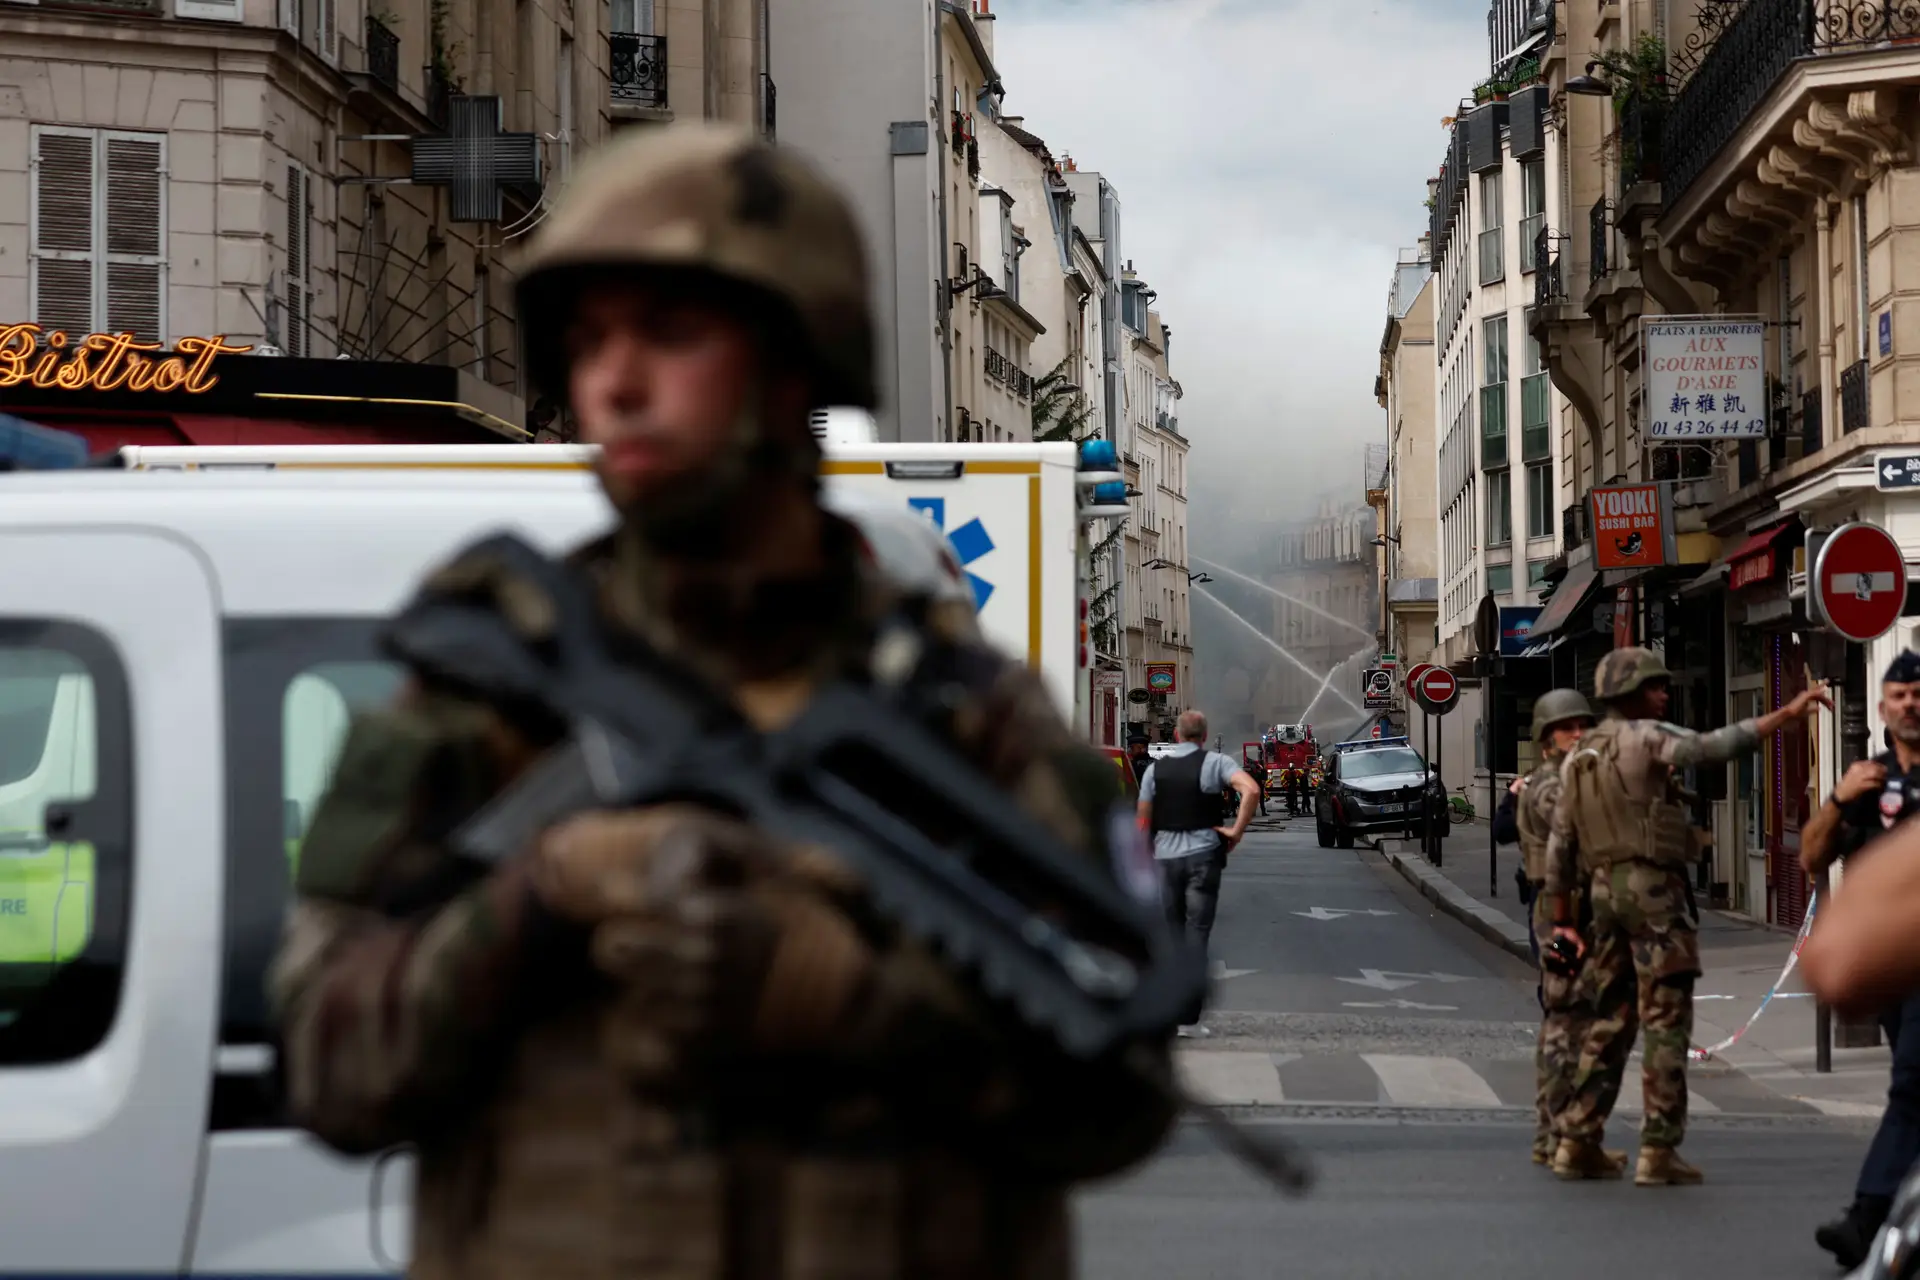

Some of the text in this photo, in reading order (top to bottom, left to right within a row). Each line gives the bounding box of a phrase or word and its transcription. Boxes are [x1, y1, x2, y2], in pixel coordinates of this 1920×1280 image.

[1650, 325, 1761, 336] PLATS A EMPORTER
[1686, 337, 1728, 353] AUX
[0, 323, 254, 394] Bistrot
[1653, 356, 1759, 372] GOURMETS
[1677, 375, 1737, 391] D'ASIE
[1669, 392, 1746, 416] 新雅凯
[1652, 419, 1763, 436] 01 43 26 44 42
[1594, 489, 1656, 516] YOOKI
[1599, 516, 1655, 530] SUSHI BAR
